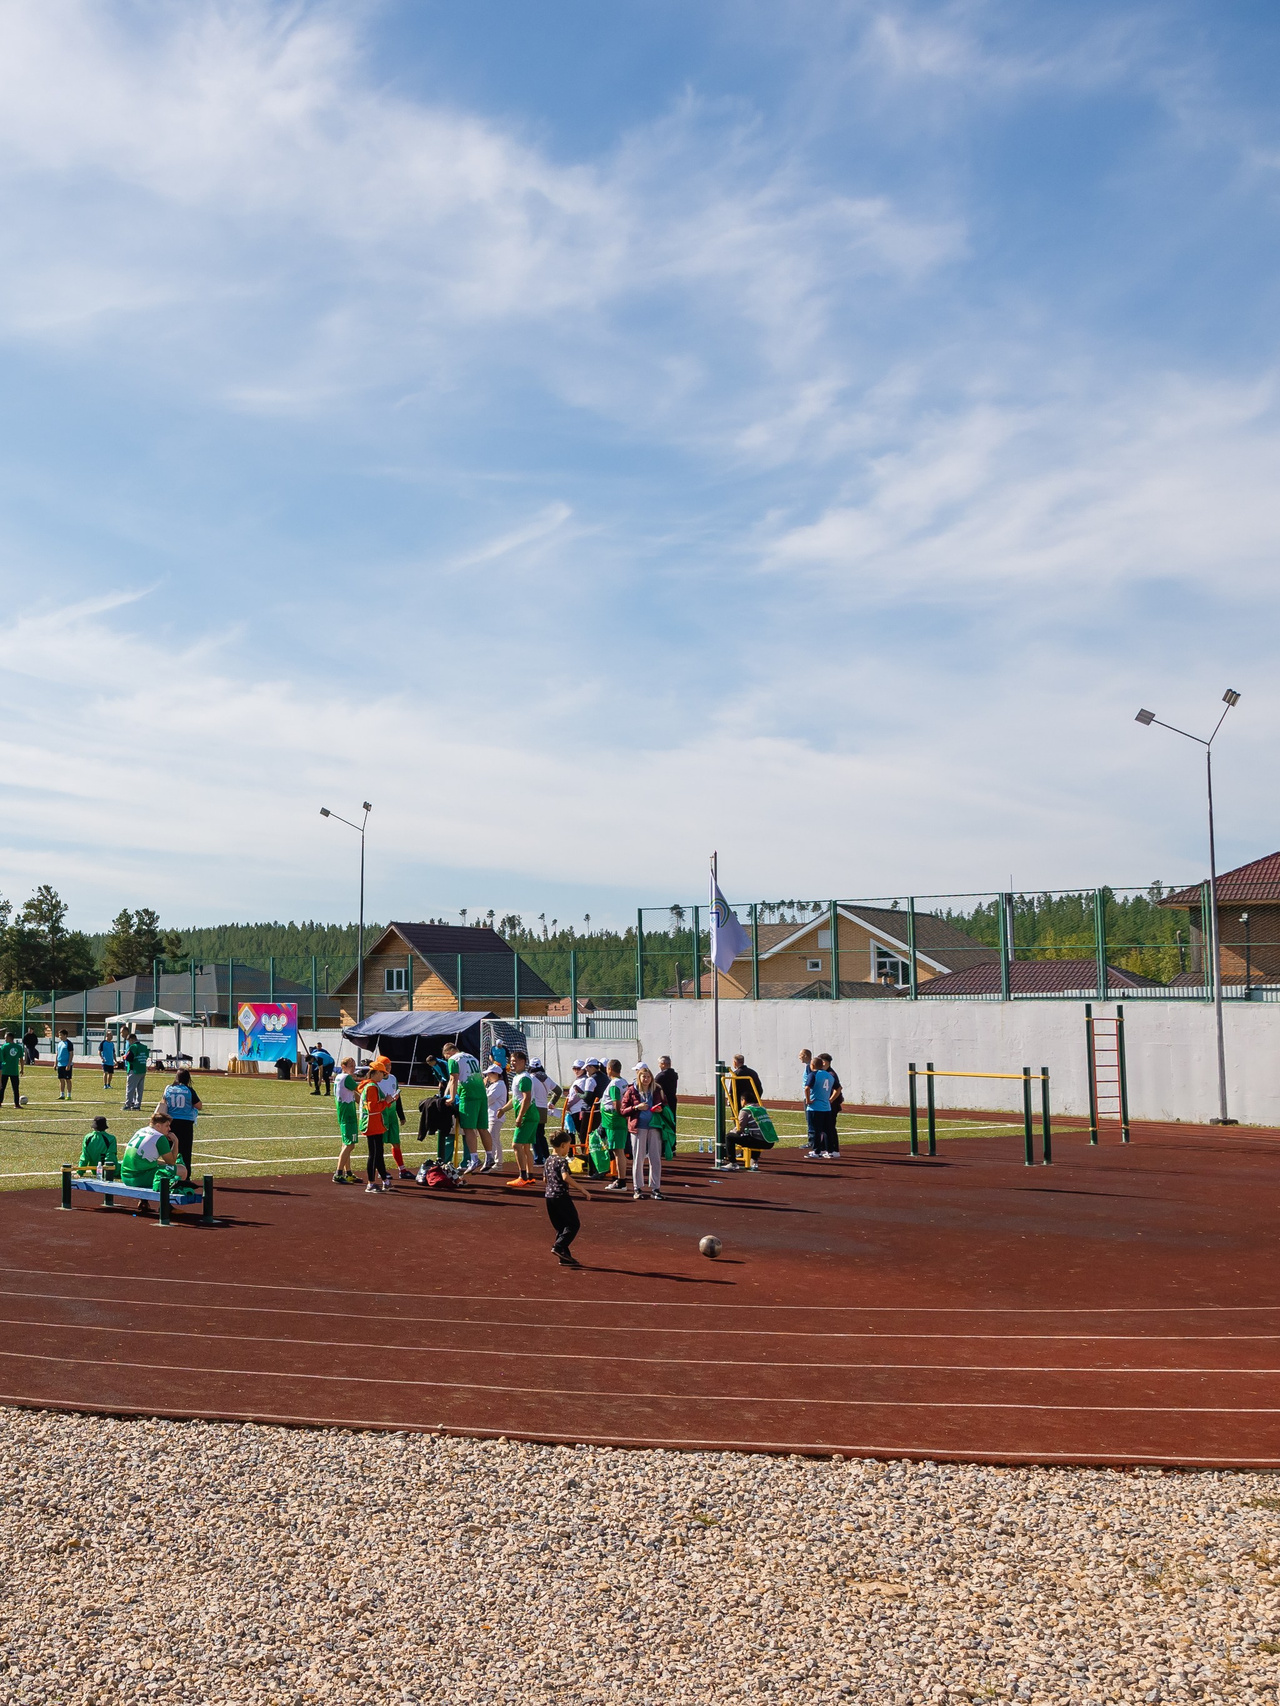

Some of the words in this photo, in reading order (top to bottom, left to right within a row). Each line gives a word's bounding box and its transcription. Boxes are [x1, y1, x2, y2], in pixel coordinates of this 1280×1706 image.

[466, 1060, 480, 1073] 10
[823, 1079, 829, 1091] 4
[170, 1094, 186, 1108] 10
[127, 1134, 146, 1149] 21
